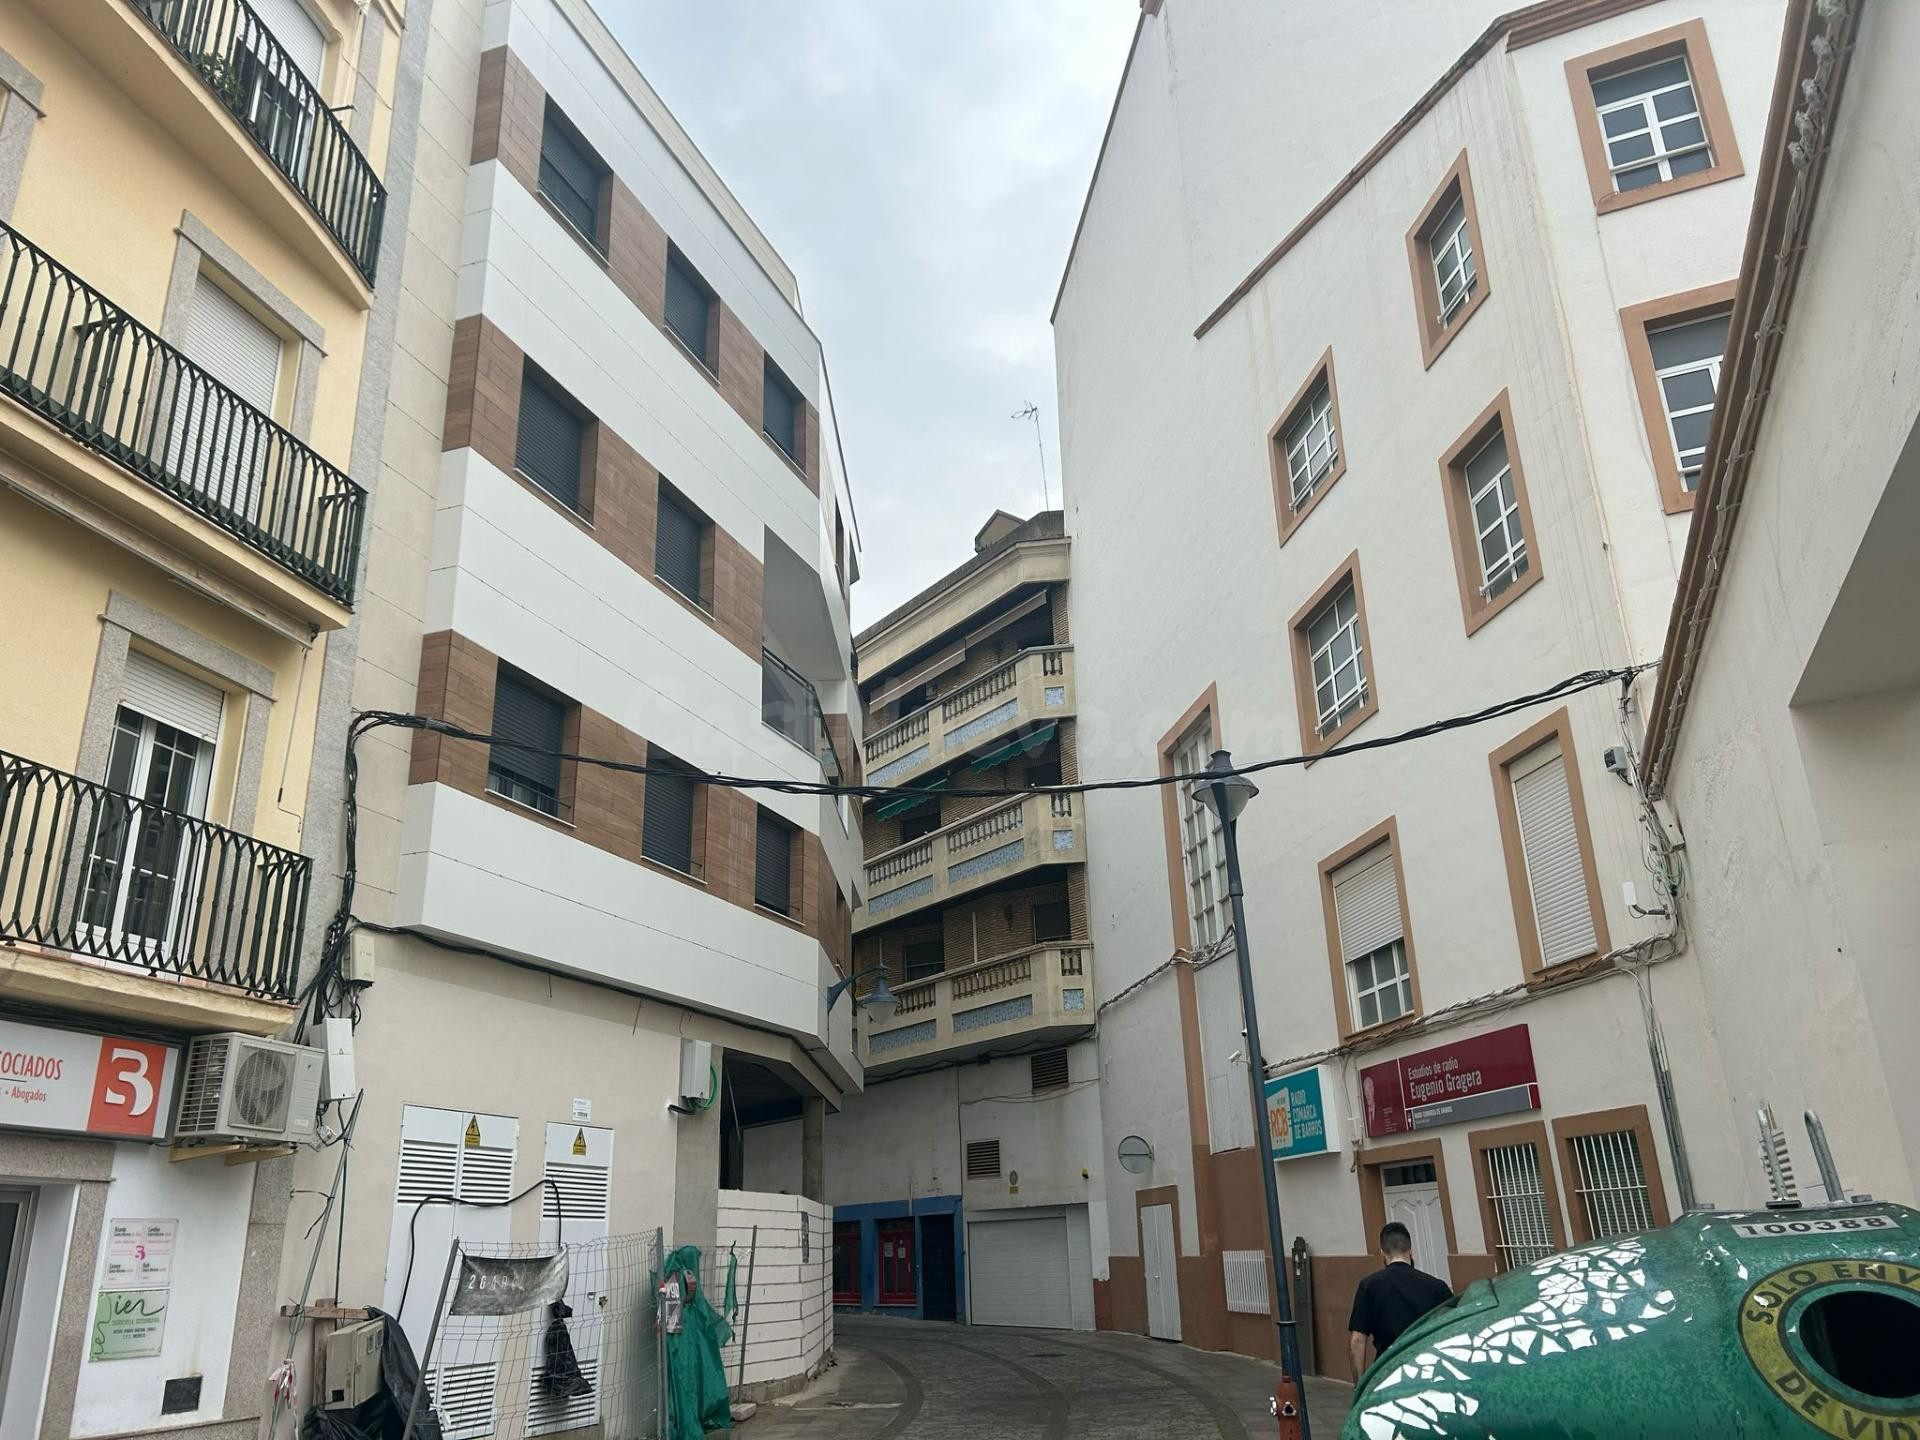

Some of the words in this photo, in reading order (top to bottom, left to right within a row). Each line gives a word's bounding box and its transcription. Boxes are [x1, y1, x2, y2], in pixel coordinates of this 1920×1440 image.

[0, 1051, 63, 1081] OCIADOS
[1408, 1064, 1433, 1080] Estudios
[1433, 1061, 1441, 1074] de
[1442, 1056, 1459, 1072] radio
[11, 1086, 47, 1104] Abogados
[1290, 1089, 1306, 1106] RADIO
[1410, 1076, 1444, 1102] Eugenio
[1446, 1070, 1482, 1093] Gragera
[1269, 1106, 1288, 1138] RCB
[1292, 1104, 1317, 1123] COMARCA
[1294, 1123, 1302, 1140] DE
[1301, 1120, 1323, 1138] BARROS
[1741, 1217, 1887, 1236] 100388
[1746, 1269, 1818, 1325] SOLO
[1775, 1370, 1829, 1417] DE
